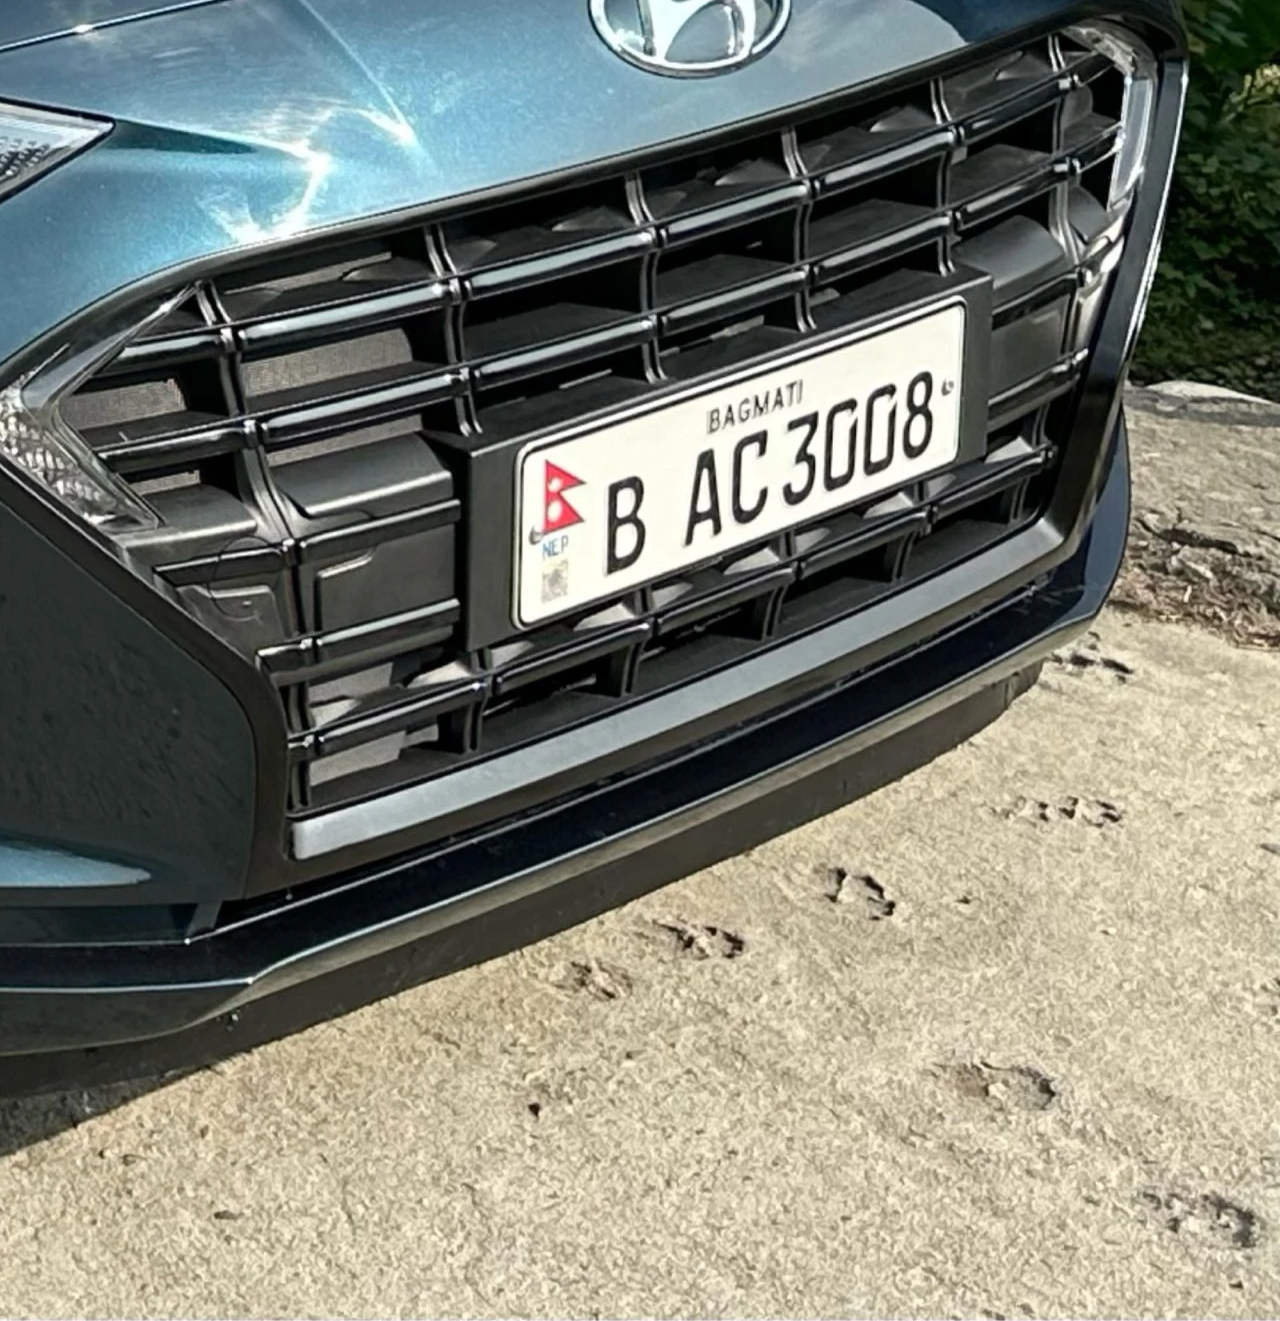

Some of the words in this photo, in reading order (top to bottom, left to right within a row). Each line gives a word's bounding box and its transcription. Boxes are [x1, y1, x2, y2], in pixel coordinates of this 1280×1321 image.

[707, 379, 804, 435] BAGMATI
[541, 534, 569, 560] NEP
[606, 475, 646, 577] B
